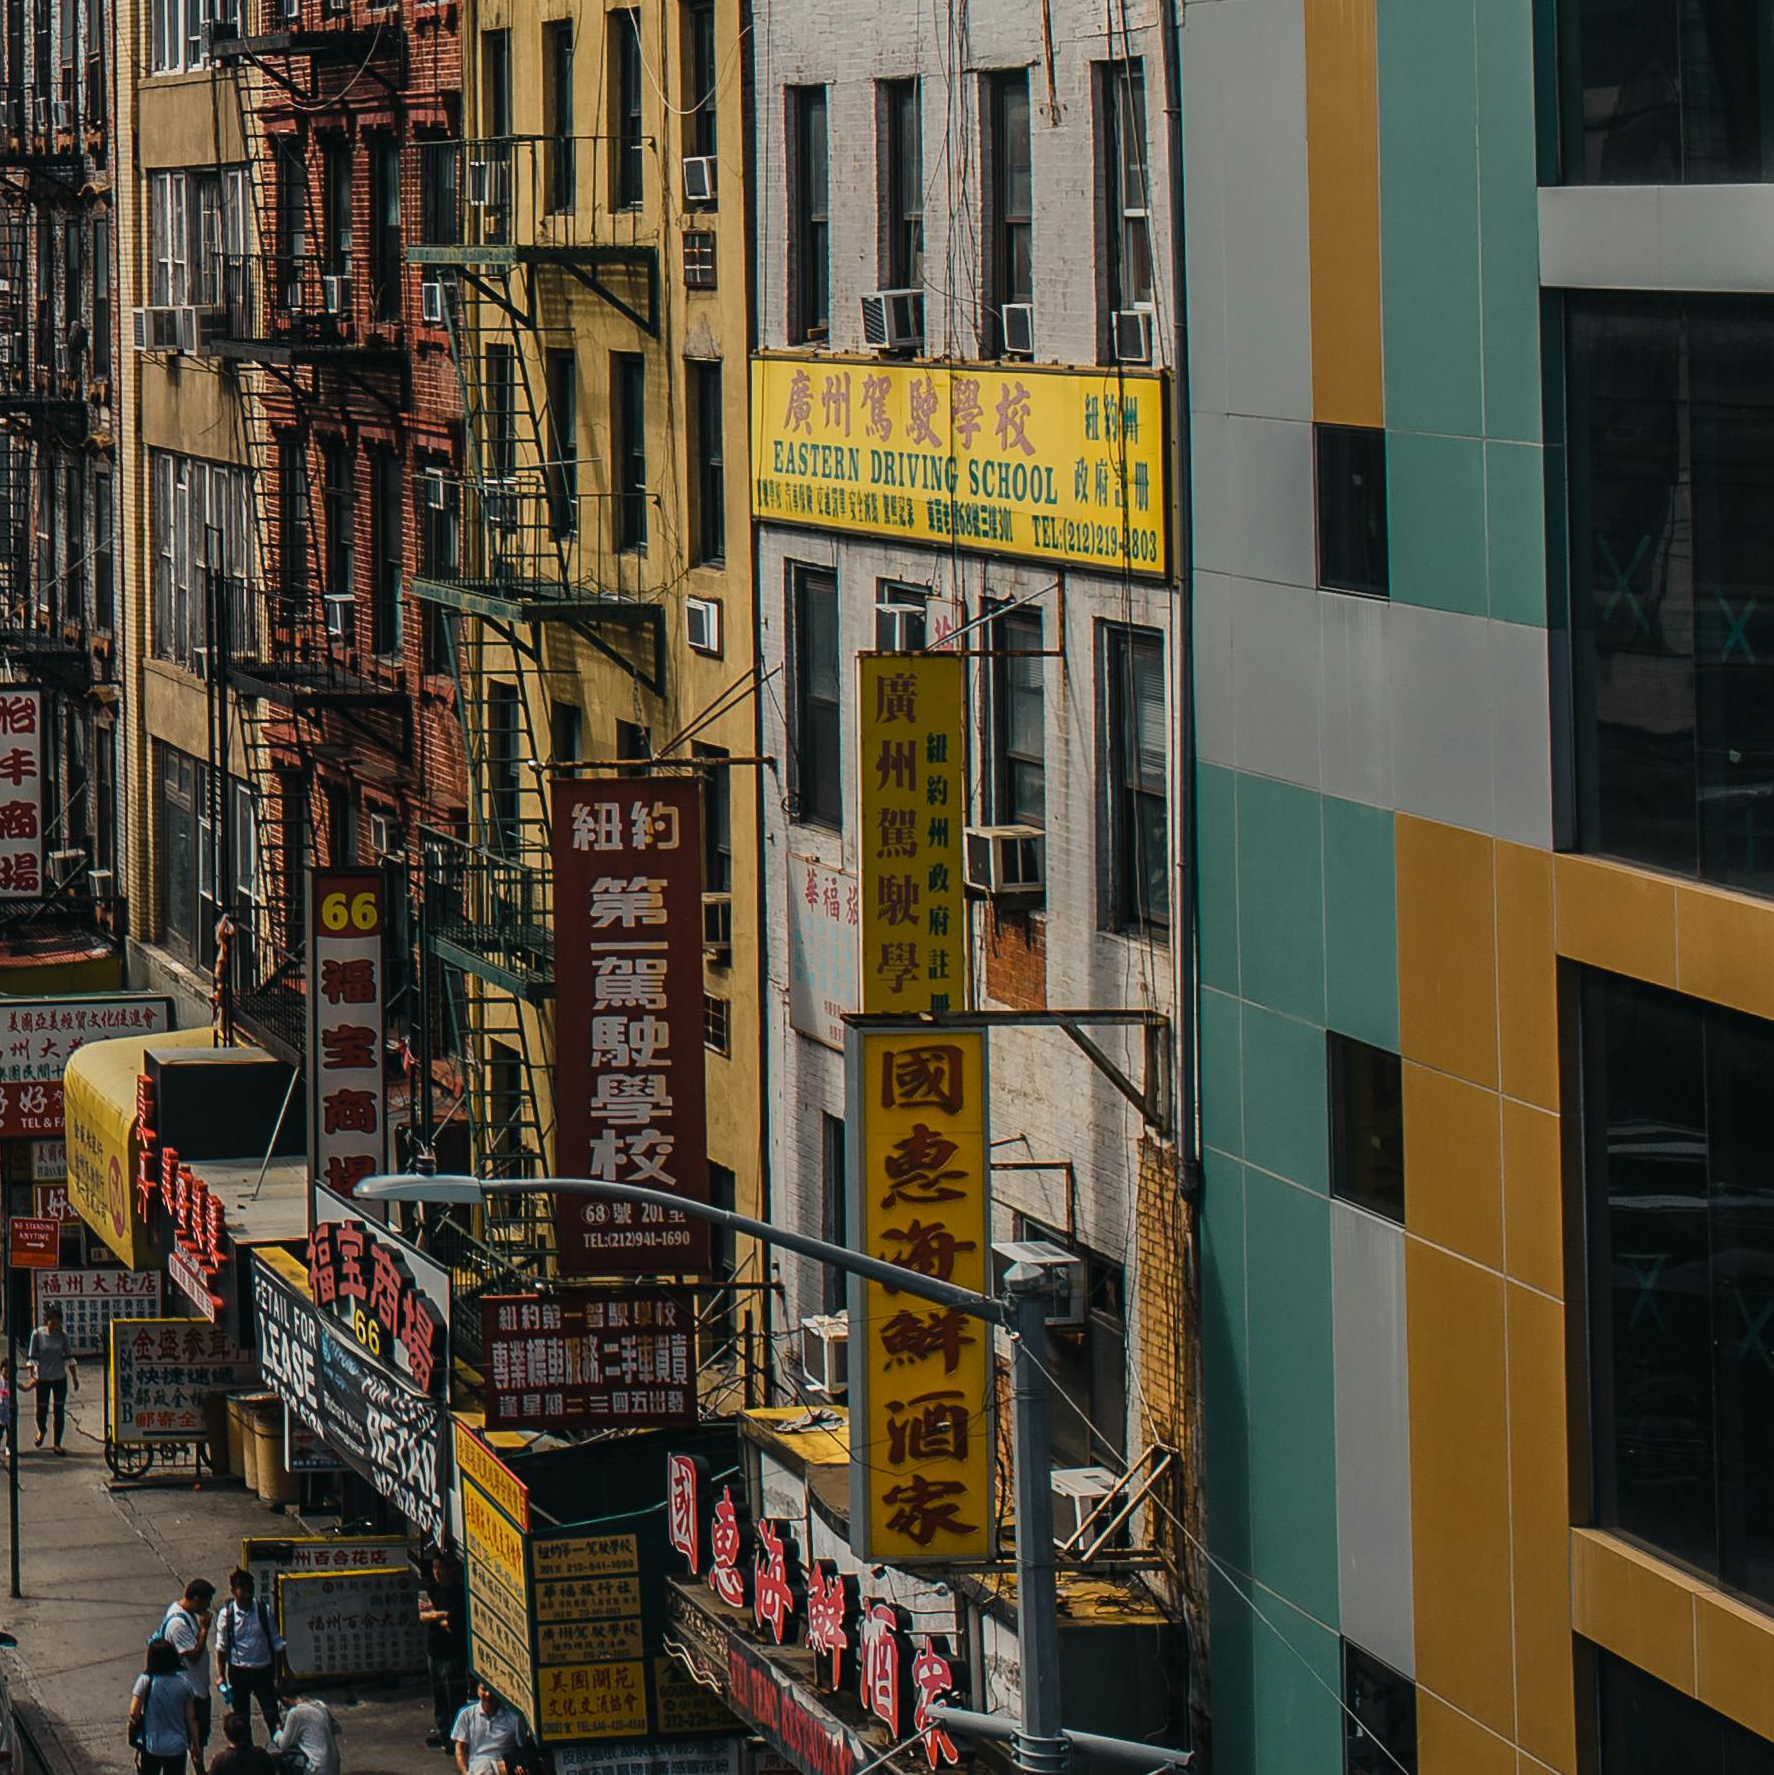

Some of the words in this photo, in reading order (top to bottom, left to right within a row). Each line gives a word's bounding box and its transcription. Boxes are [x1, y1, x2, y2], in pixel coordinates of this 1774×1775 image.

[784, 370, 1037, 456] 廣州駕駛學校
[1085, 393, 1139, 445] 紐約州
[773, 440, 860, 481] EASTERN
[870, 449, 958, 494] DRIVING
[969, 458, 1058, 505] SCHOOL
[571, 801, 681, 852] 紐約
[875, 673, 922, 997] 廣州駕駛學
[322, 892, 377, 931] 66
[804, 868, 859, 925] 華福旅
[589, 876, 677, 1186] 第一駕駛學校
[21, 1117, 41, 1129] TEL
[585, 1204, 607, 1224] 68
[584, 1231, 691, 1249] TEL:(212)941-1690
[293, 1306, 317, 1351] FOR
[353, 1309, 381, 1357] 66
[259, 1312, 319, 1410] LEASE
[366, 1403, 441, 1508] RETAIL
[276, 1549, 388, 1567] 州百合花店
